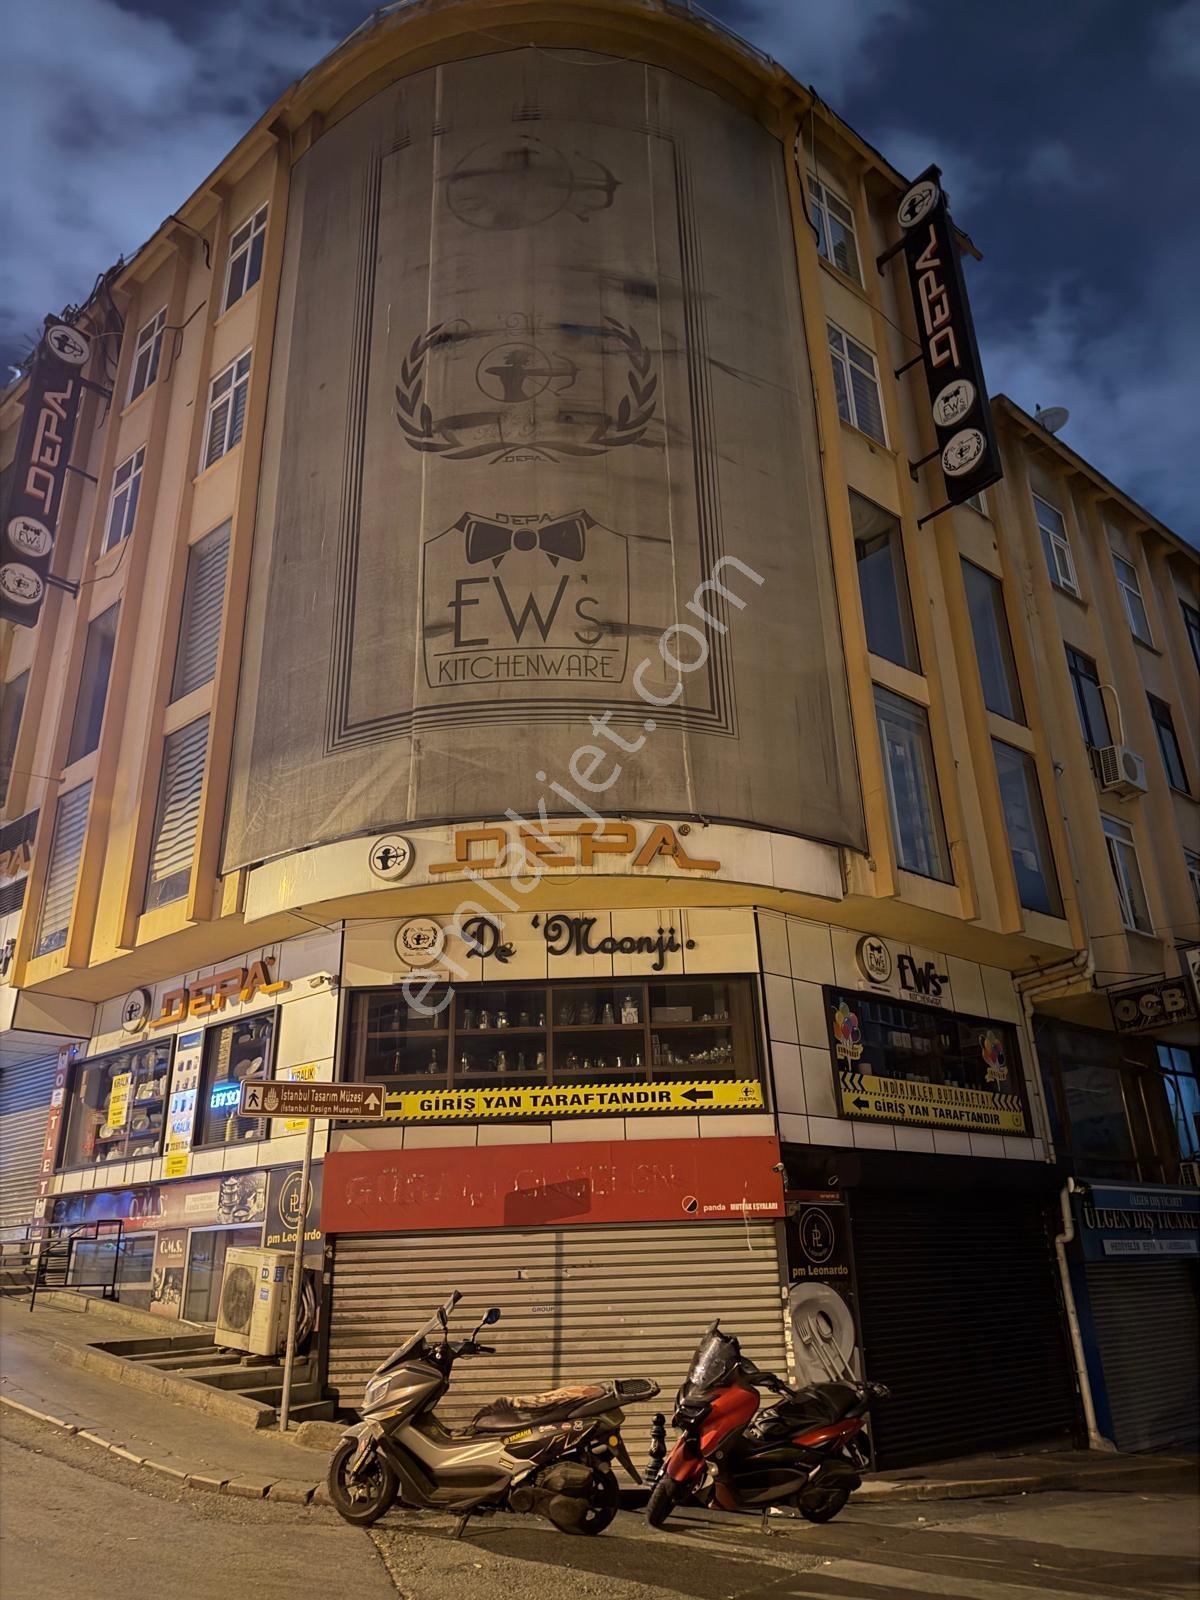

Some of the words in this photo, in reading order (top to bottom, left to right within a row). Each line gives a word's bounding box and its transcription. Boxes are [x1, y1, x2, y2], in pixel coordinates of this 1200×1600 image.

[915, 223, 961, 369] DEPA
[24, 378, 74, 516] DEPA
[495, 512, 554, 526] DEPA
[438, 654, 614, 683] KITCHENWARE
[428, 822, 721, 875] DEPA
[460, 915, 518, 963] De
[149, 960, 291, 1029] DEPA
[280, 1085, 310, 1102] İstanbul
[311, 1089, 338, 1103] Tasarım
[339, 1090, 364, 1103] Müzesi
[419, 1095, 476, 1113] GİRİŞ
[482, 1096, 522, 1109] YAN
[529, 1090, 672, 1107] TARAFTANDIR
[310, 1105, 332, 1115] Design
[333, 1105, 362, 1114] Museum)
[874, 1099, 906, 1117] GİRİŞ
[907, 1104, 930, 1118] YAN
[932, 1107, 1001, 1125] TARAFTANDIR
[703, 1203, 726, 1213] panda
[267, 1234, 280, 1247] pm
[792, 1267, 806, 1279] pm
[808, 1264, 849, 1276] Leonardo
[508, 1427, 533, 1442] YAMAHA
